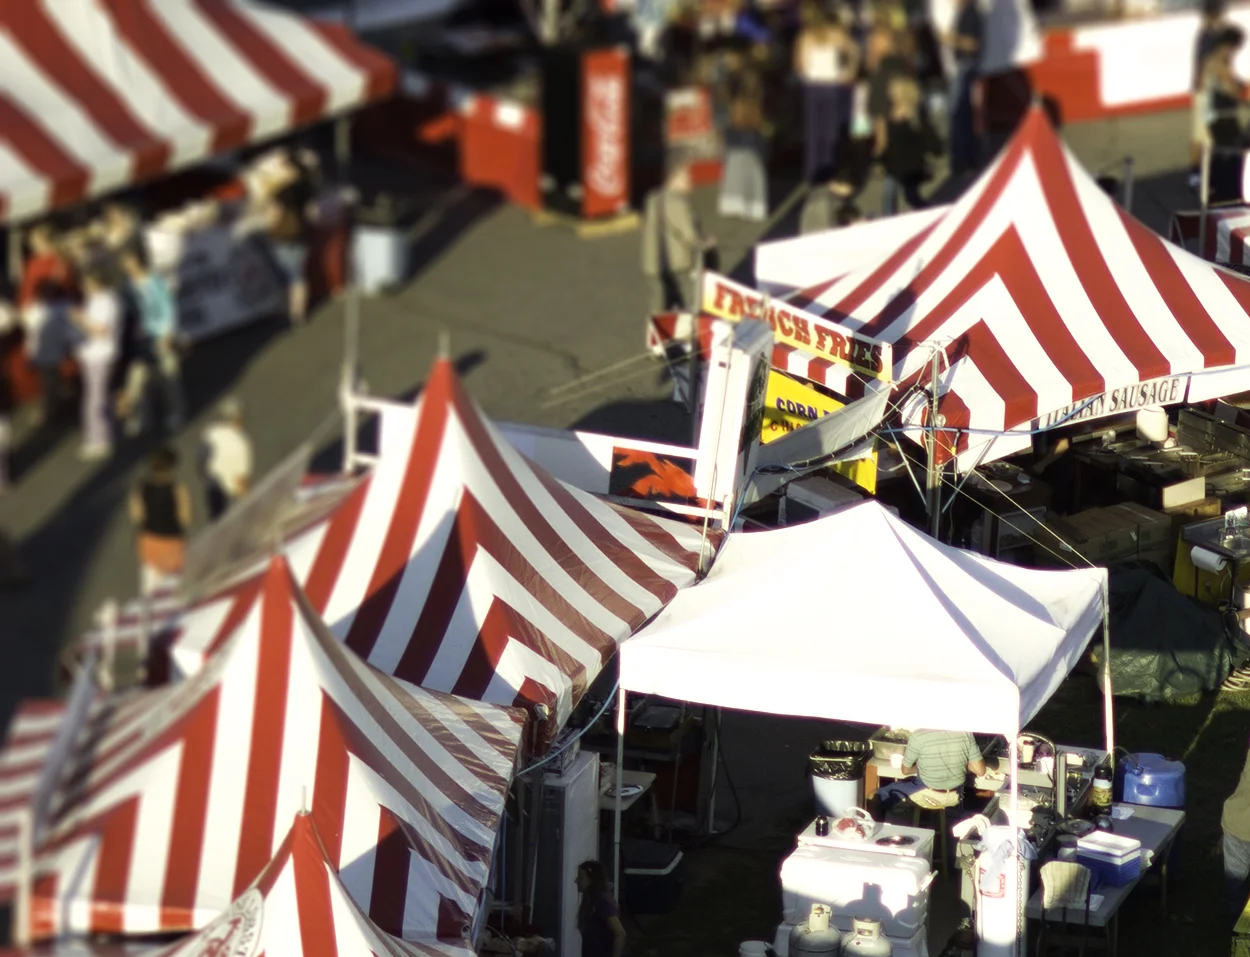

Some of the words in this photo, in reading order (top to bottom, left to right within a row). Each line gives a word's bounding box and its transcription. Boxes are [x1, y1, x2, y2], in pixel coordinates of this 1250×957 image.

[814, 322, 884, 375] FRIES
[776, 396, 818, 421] CORN
[1108, 378, 1180, 413] SAUSAGE
